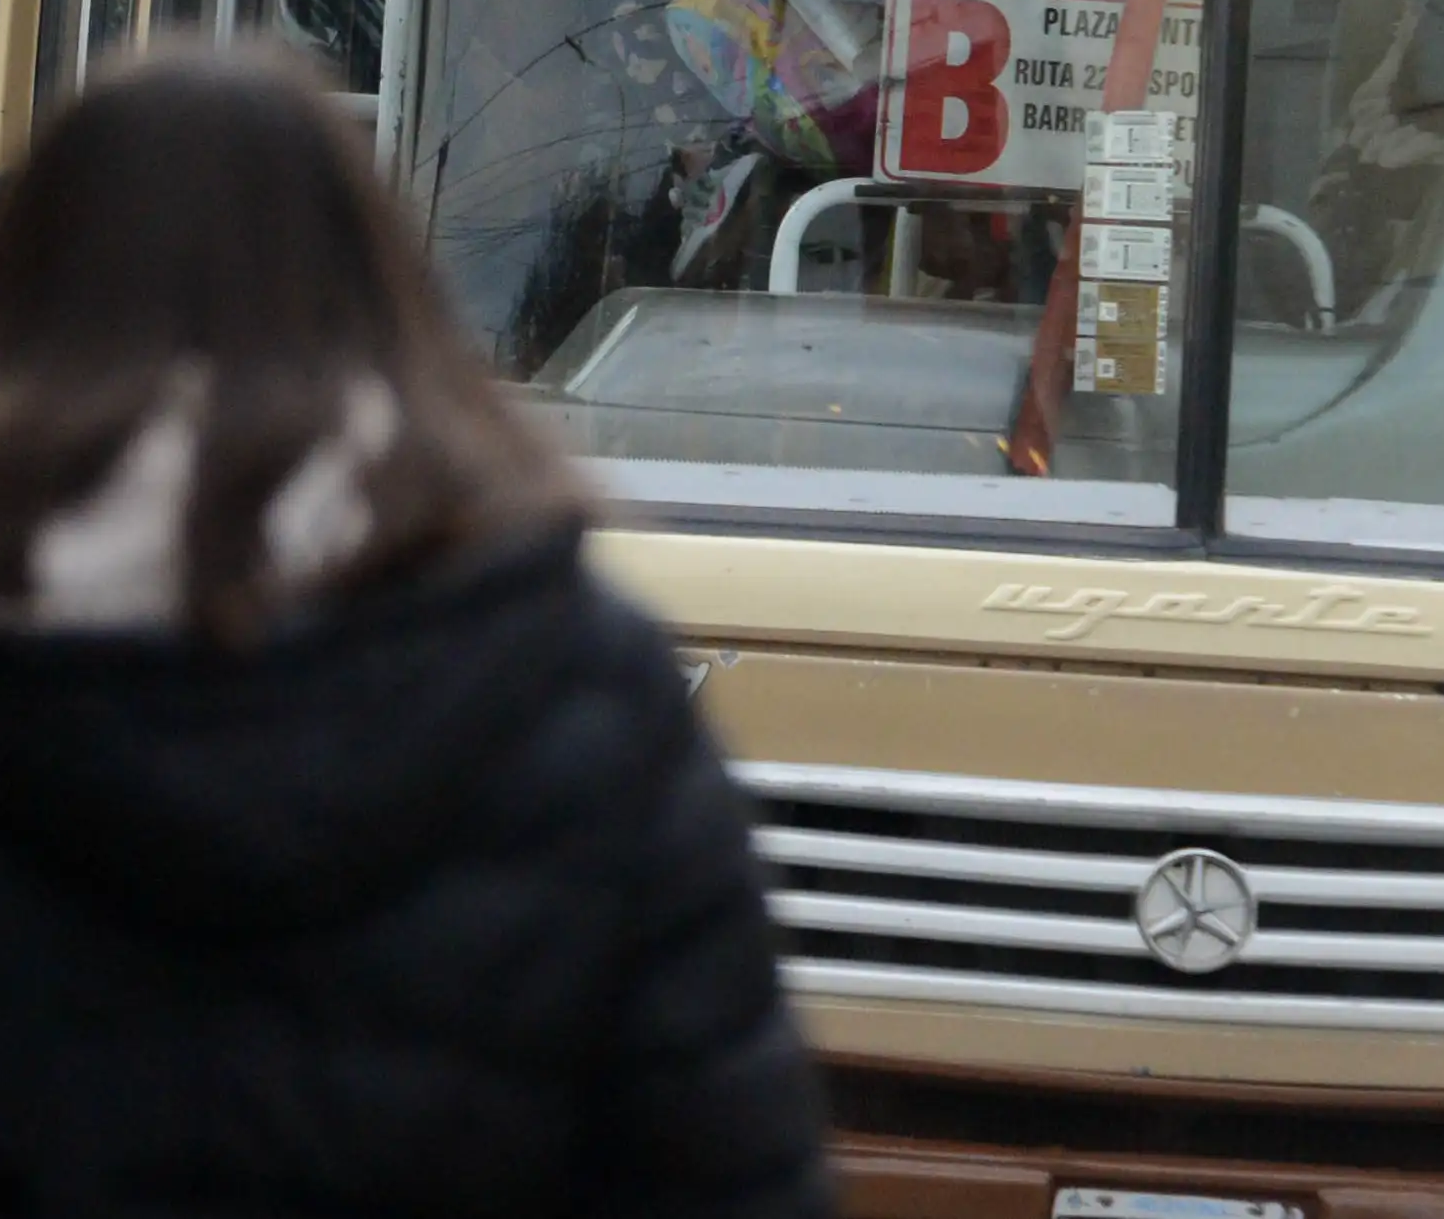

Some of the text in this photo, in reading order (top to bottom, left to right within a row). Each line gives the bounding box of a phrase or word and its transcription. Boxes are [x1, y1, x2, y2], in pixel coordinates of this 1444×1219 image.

[1043, 6, 1120, 40] PLAZA
[1014, 58, 1195, 98] RUTA 22 SPO
[1022, 102, 1087, 133] BARR
[981, 582, 1434, 641] ugarte
